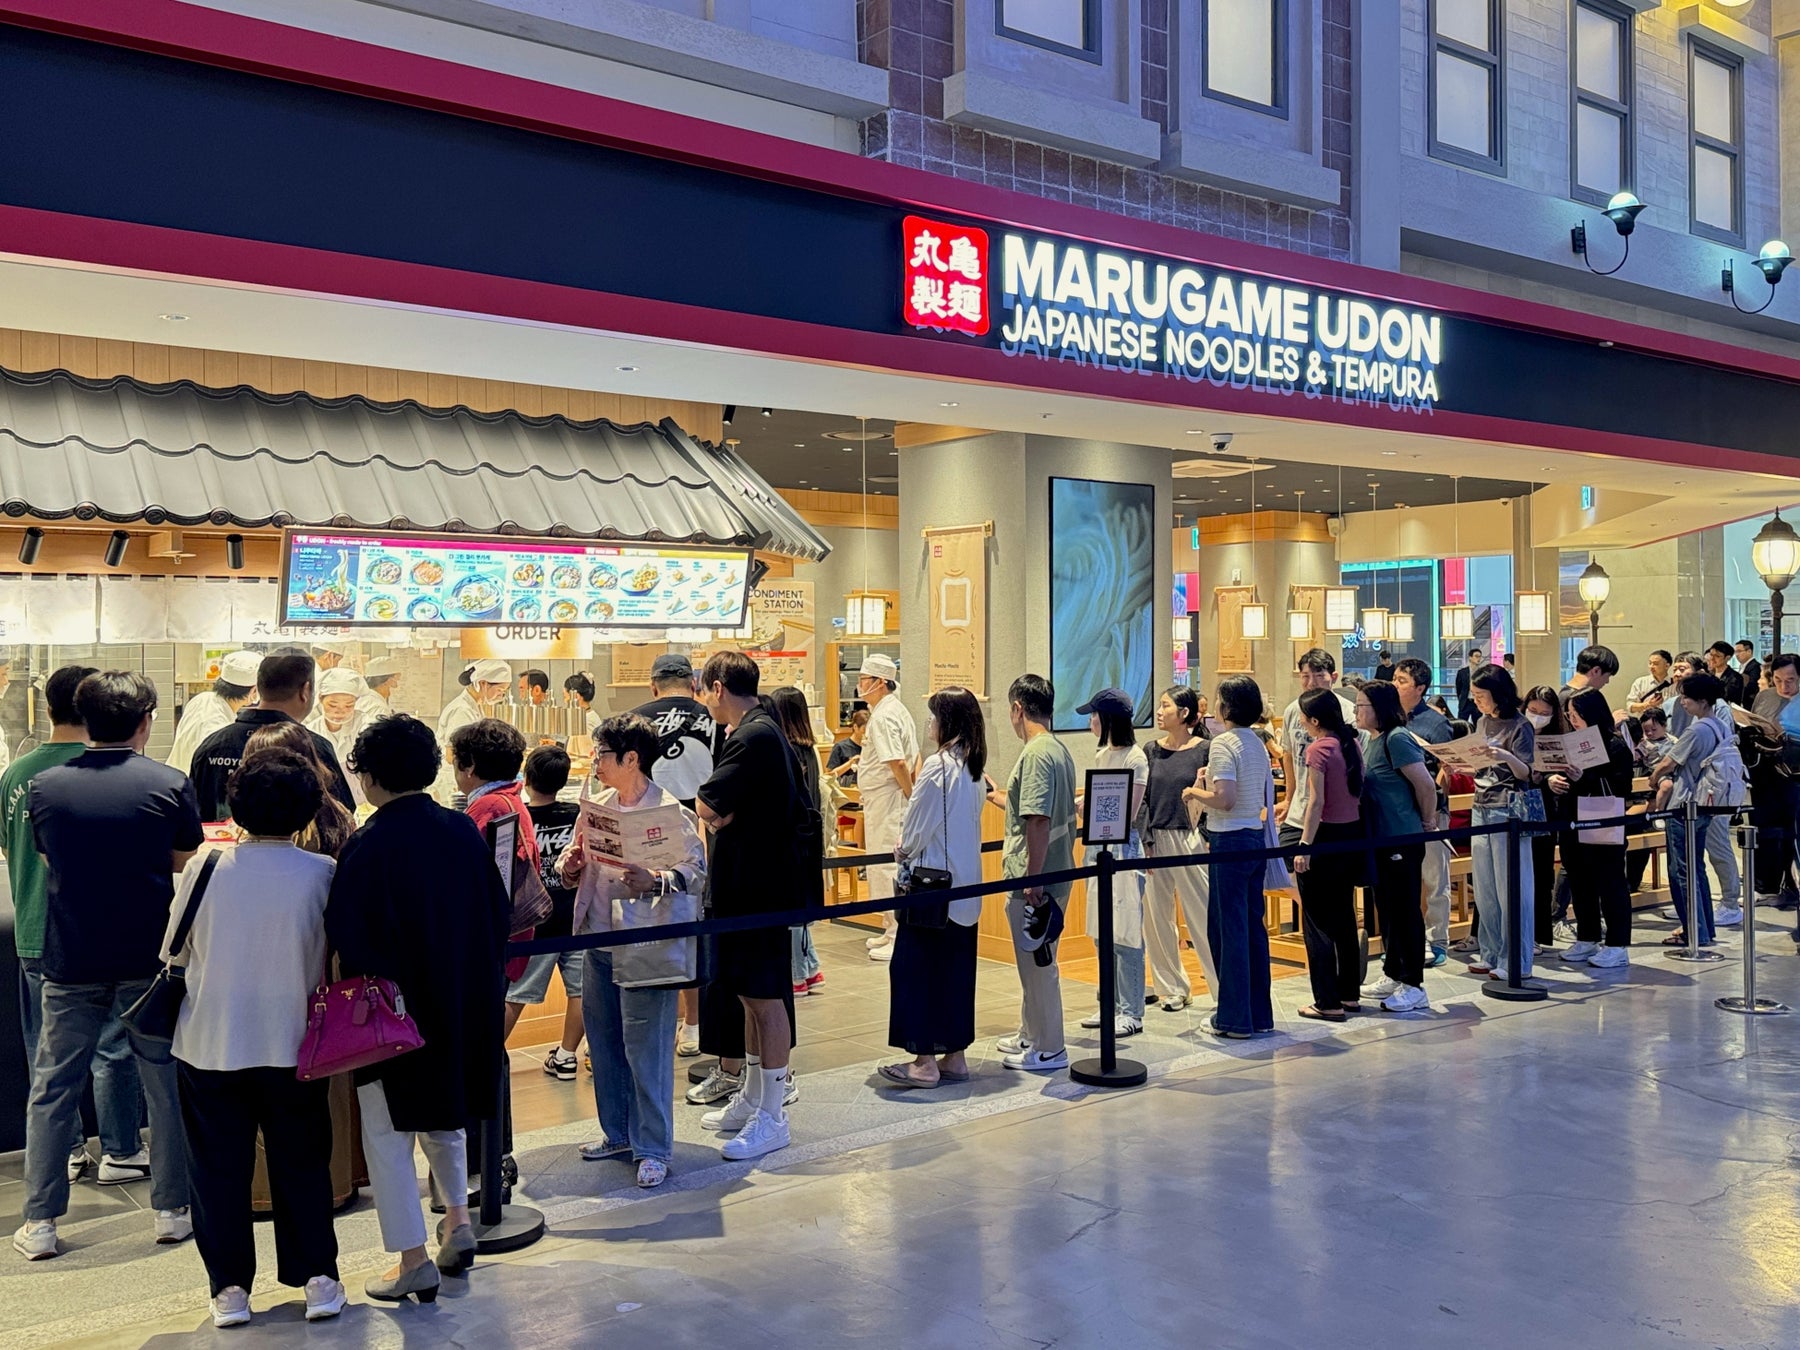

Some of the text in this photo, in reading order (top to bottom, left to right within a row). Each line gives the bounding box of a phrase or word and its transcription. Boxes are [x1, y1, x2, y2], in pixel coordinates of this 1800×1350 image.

[910, 229, 982, 280] 丸亀
[1004, 235, 1440, 365] MARUGAME UDON
[1002, 304, 1438, 402] JAPANESE NOODLES & TEMPURA
[764, 600, 804, 608] STATION
[496, 626, 561, 640] ORDER
